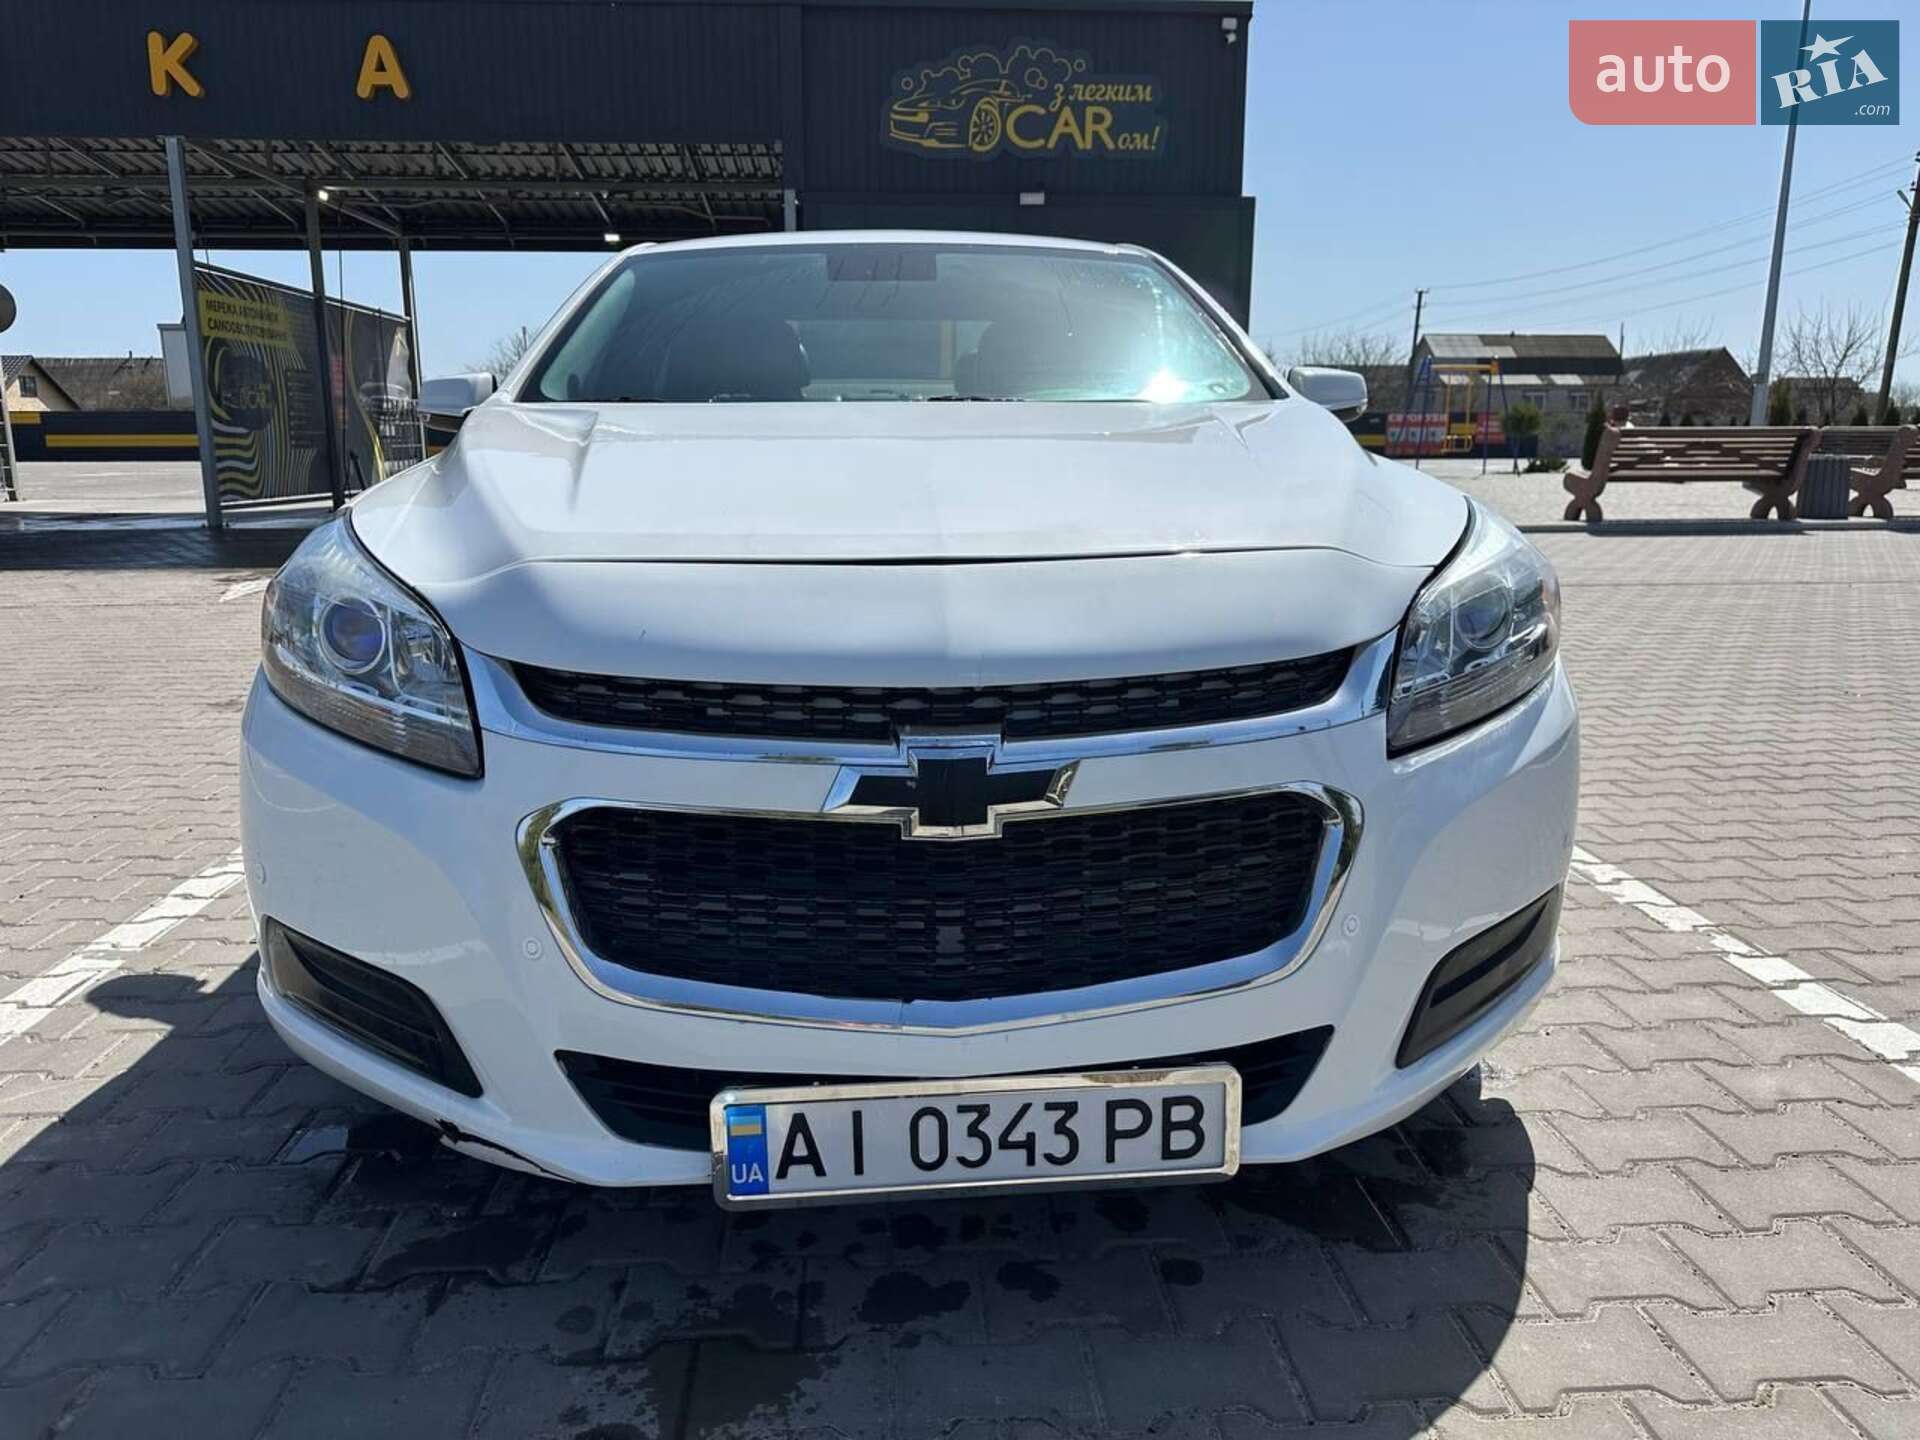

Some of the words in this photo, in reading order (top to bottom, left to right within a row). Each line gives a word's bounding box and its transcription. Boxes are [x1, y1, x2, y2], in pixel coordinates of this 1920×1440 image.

[1068, 82, 1153, 102] легким
[908, 1101, 1080, 1173] 0343
[1104, 1095, 1206, 1164] PB
[732, 1170, 765, 1186] UA
